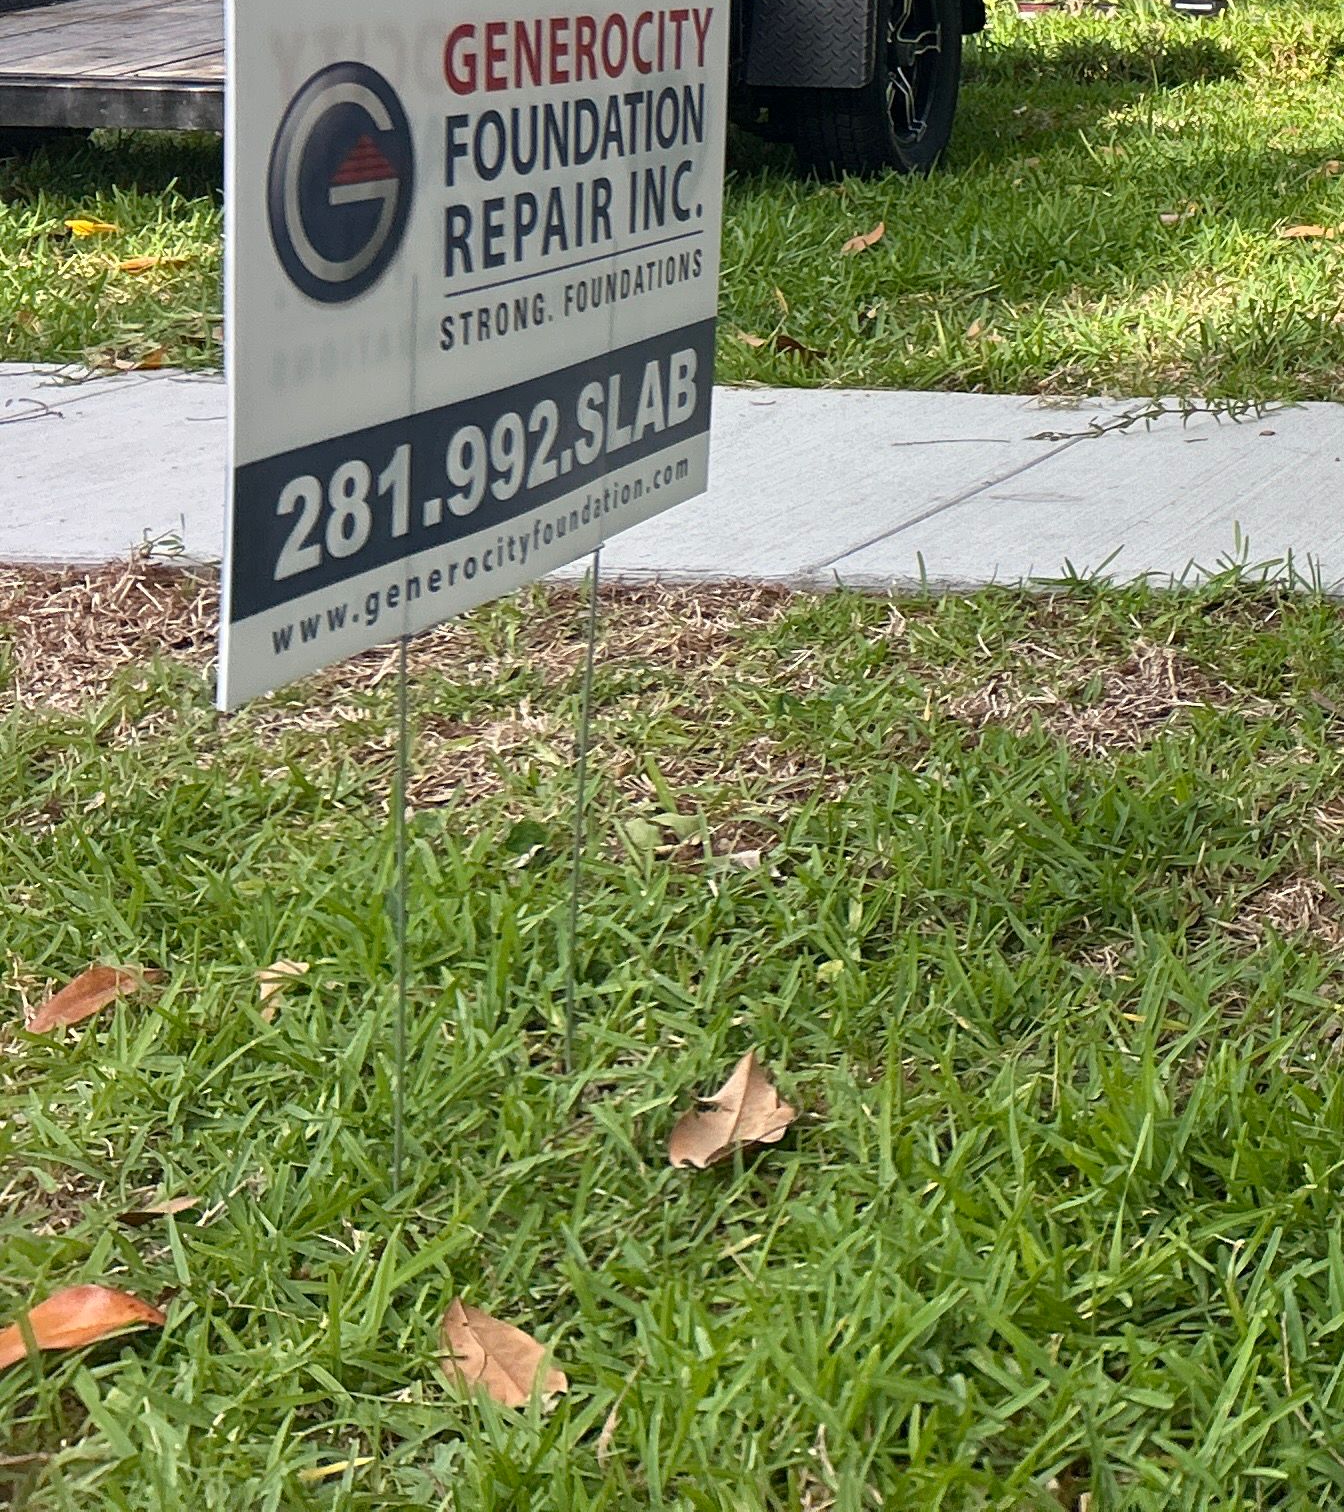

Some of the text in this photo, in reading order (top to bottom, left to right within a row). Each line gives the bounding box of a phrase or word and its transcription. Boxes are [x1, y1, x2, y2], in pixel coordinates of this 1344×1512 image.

[443, 7, 714, 96] GENEROCITY
[444, 84, 706, 187] FOUNDATION
[444, 159, 704, 278] REPAIR INC.
[440, 248, 703, 351] STRONG. FOUNDATIONS
[273, 347, 699, 581] 281.992.SLAB
[271, 455, 689, 656] www.generocityfoundation.com
